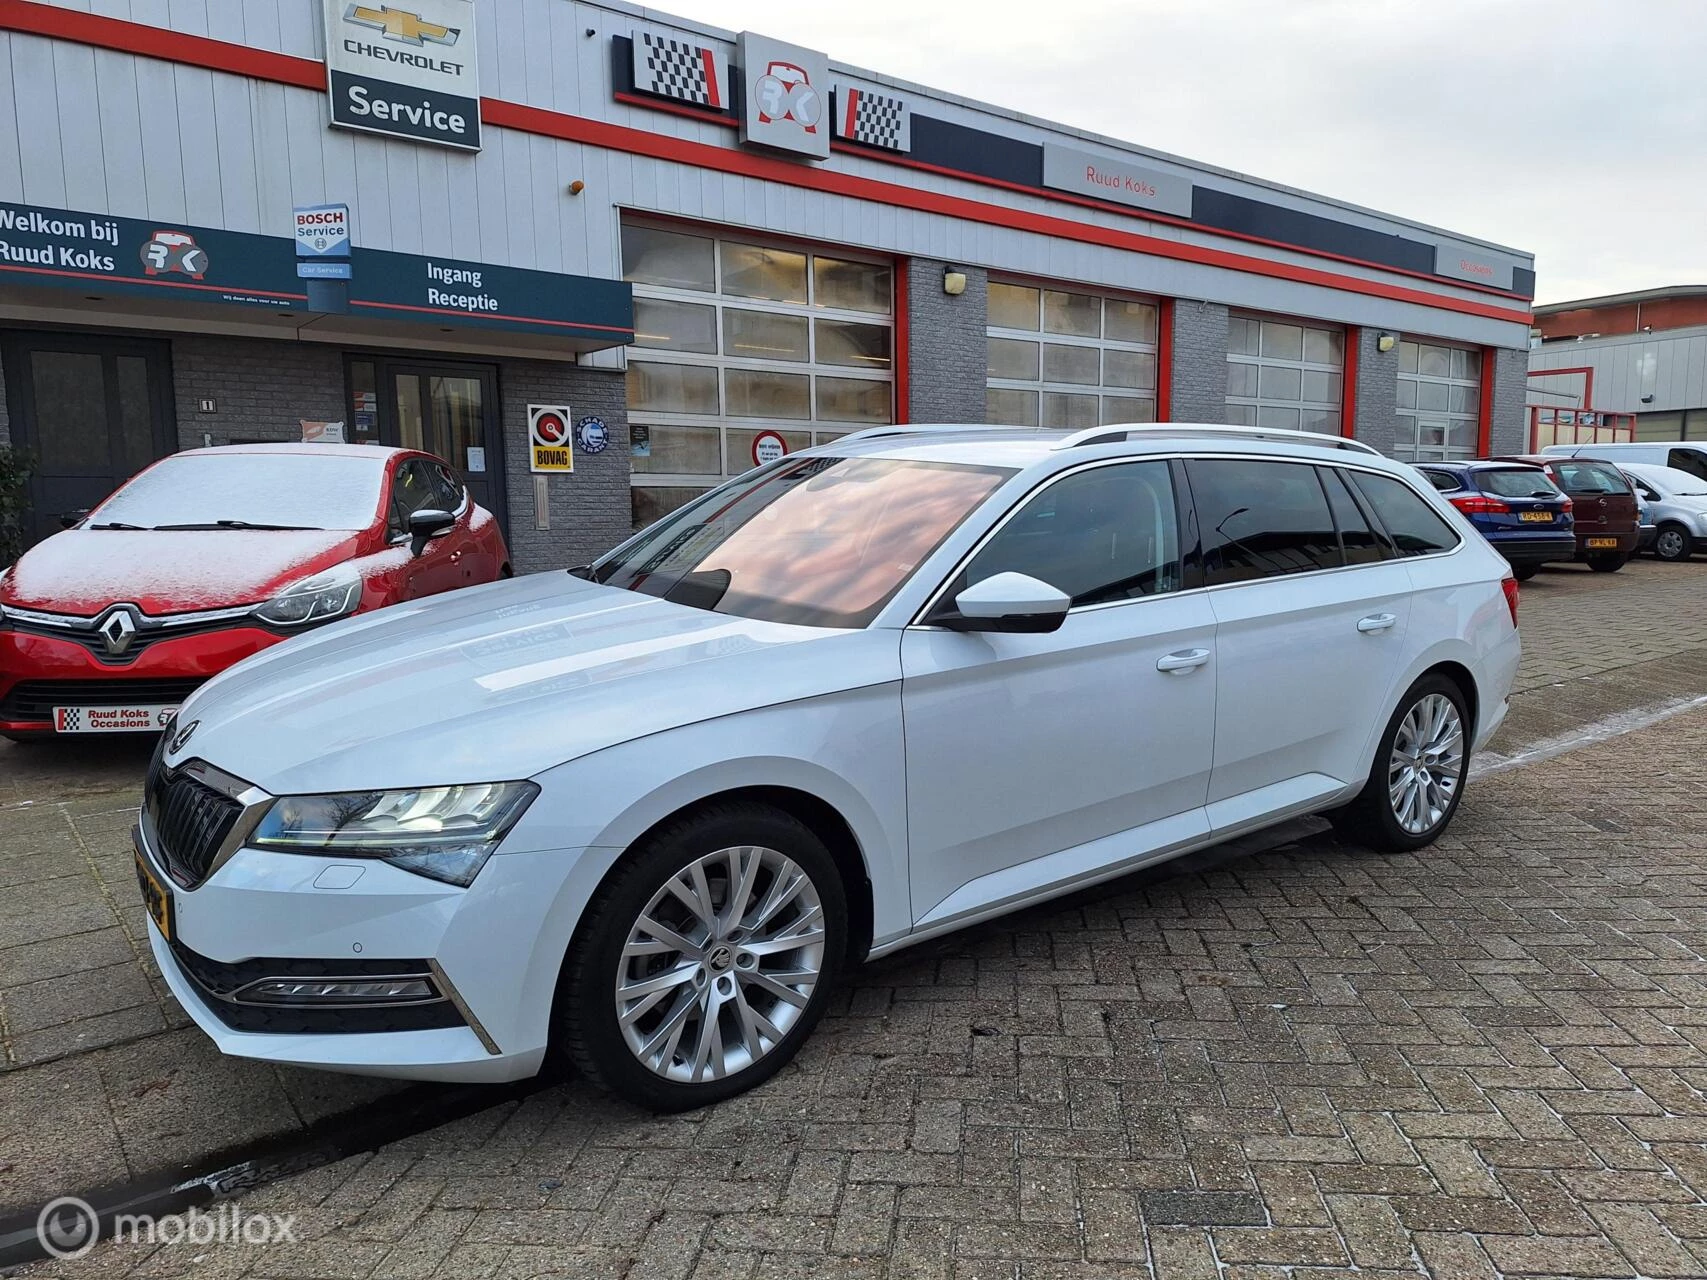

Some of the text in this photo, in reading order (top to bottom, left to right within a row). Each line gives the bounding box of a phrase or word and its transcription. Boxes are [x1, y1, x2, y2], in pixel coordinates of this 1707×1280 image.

[343, 39, 464, 76] CHEVROLET
[348, 85, 466, 134] Service
[1086, 166, 1156, 197] Ruud Koks
[296, 212, 344, 225] BOSCH
[91, 219, 119, 246] bij
[297, 226, 345, 237] Service
[60, 247, 115, 271] Koks
[302, 266, 344, 275] Car Service
[427, 262, 482, 288] Ingang
[427, 288, 499, 312] Receptie
[536, 450, 568, 466] BOVAG
[88, 710, 117, 719] Ruud
[120, 709, 149, 719] Koks
[91, 718, 150, 728] Occasions
